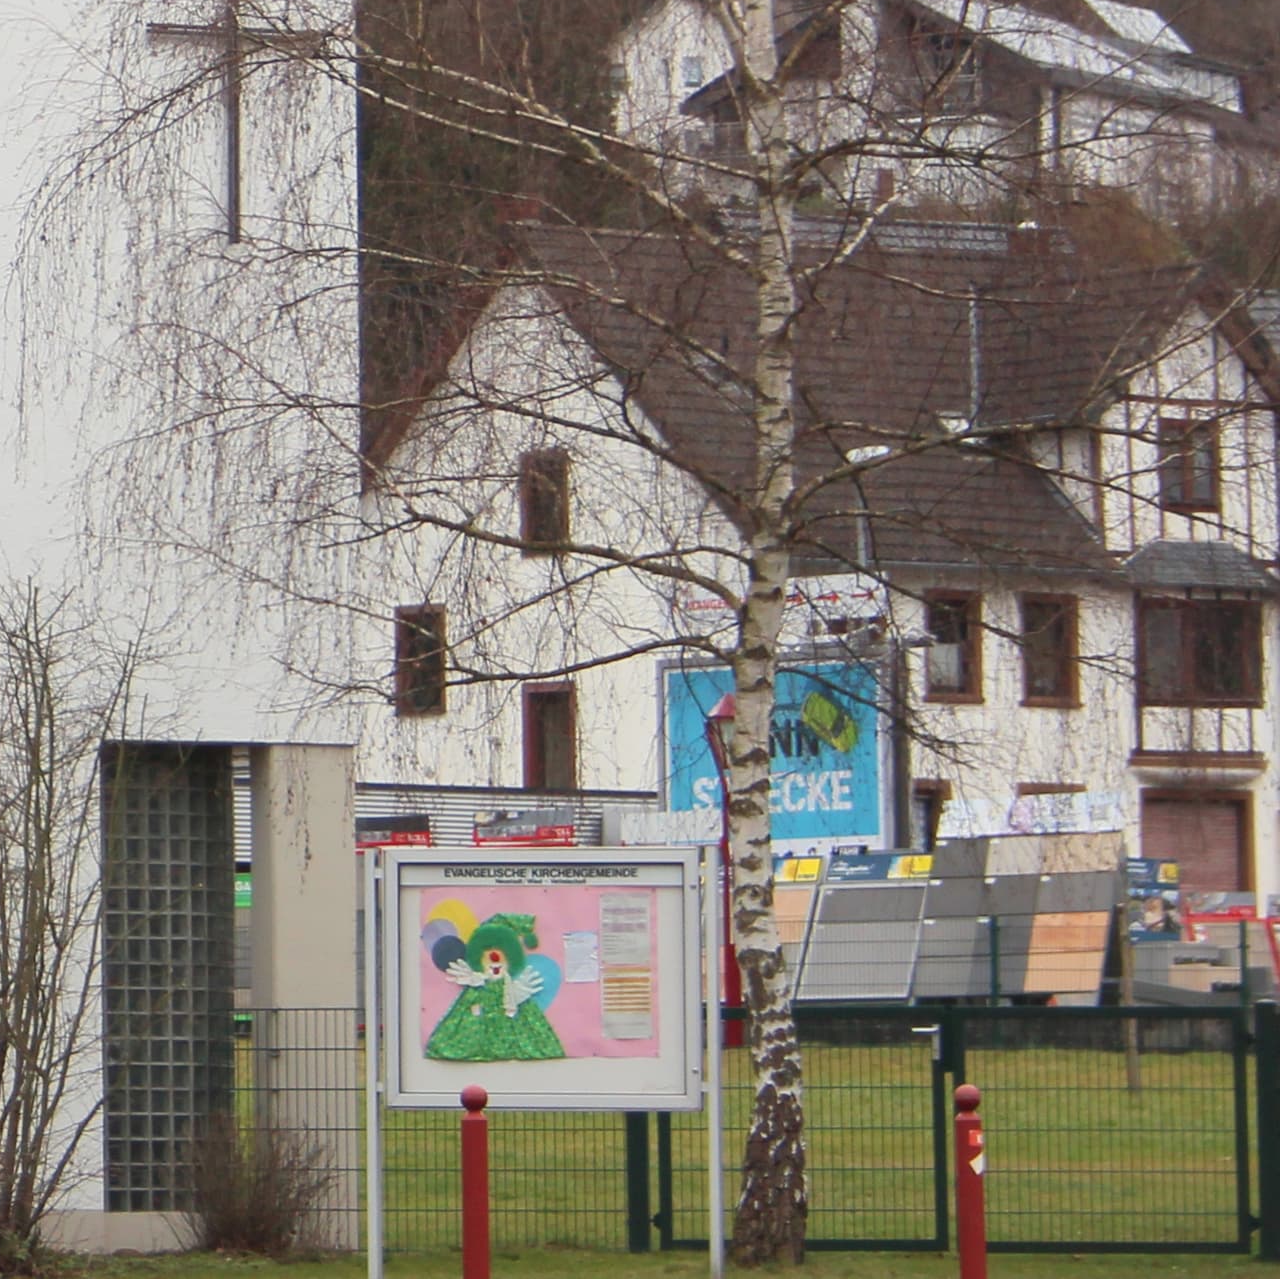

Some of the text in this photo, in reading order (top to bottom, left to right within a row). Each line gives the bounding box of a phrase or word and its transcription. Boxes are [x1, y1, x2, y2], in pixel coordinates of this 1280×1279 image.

[692, 769, 853, 814] SECKE
[444, 867, 639, 878] EVANGELISCHE KIRCHENGEMEINDE
